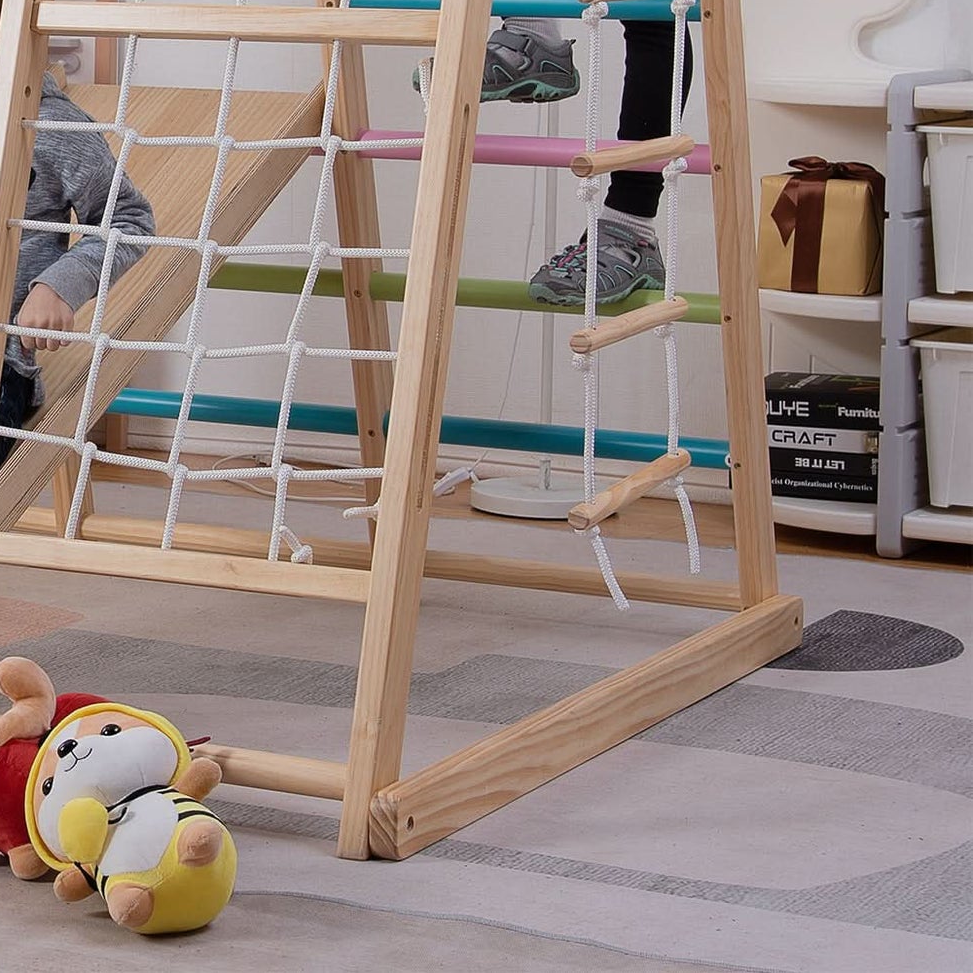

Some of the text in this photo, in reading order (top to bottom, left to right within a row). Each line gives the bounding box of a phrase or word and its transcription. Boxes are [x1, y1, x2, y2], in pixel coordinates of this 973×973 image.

[766, 400, 810, 417] UYE
[772, 429, 836, 446] CRAFT
[794, 457, 845, 470] LET IT BE
[784, 478, 833, 489] Organizational
[833, 482, 873, 492] Cybernetics
